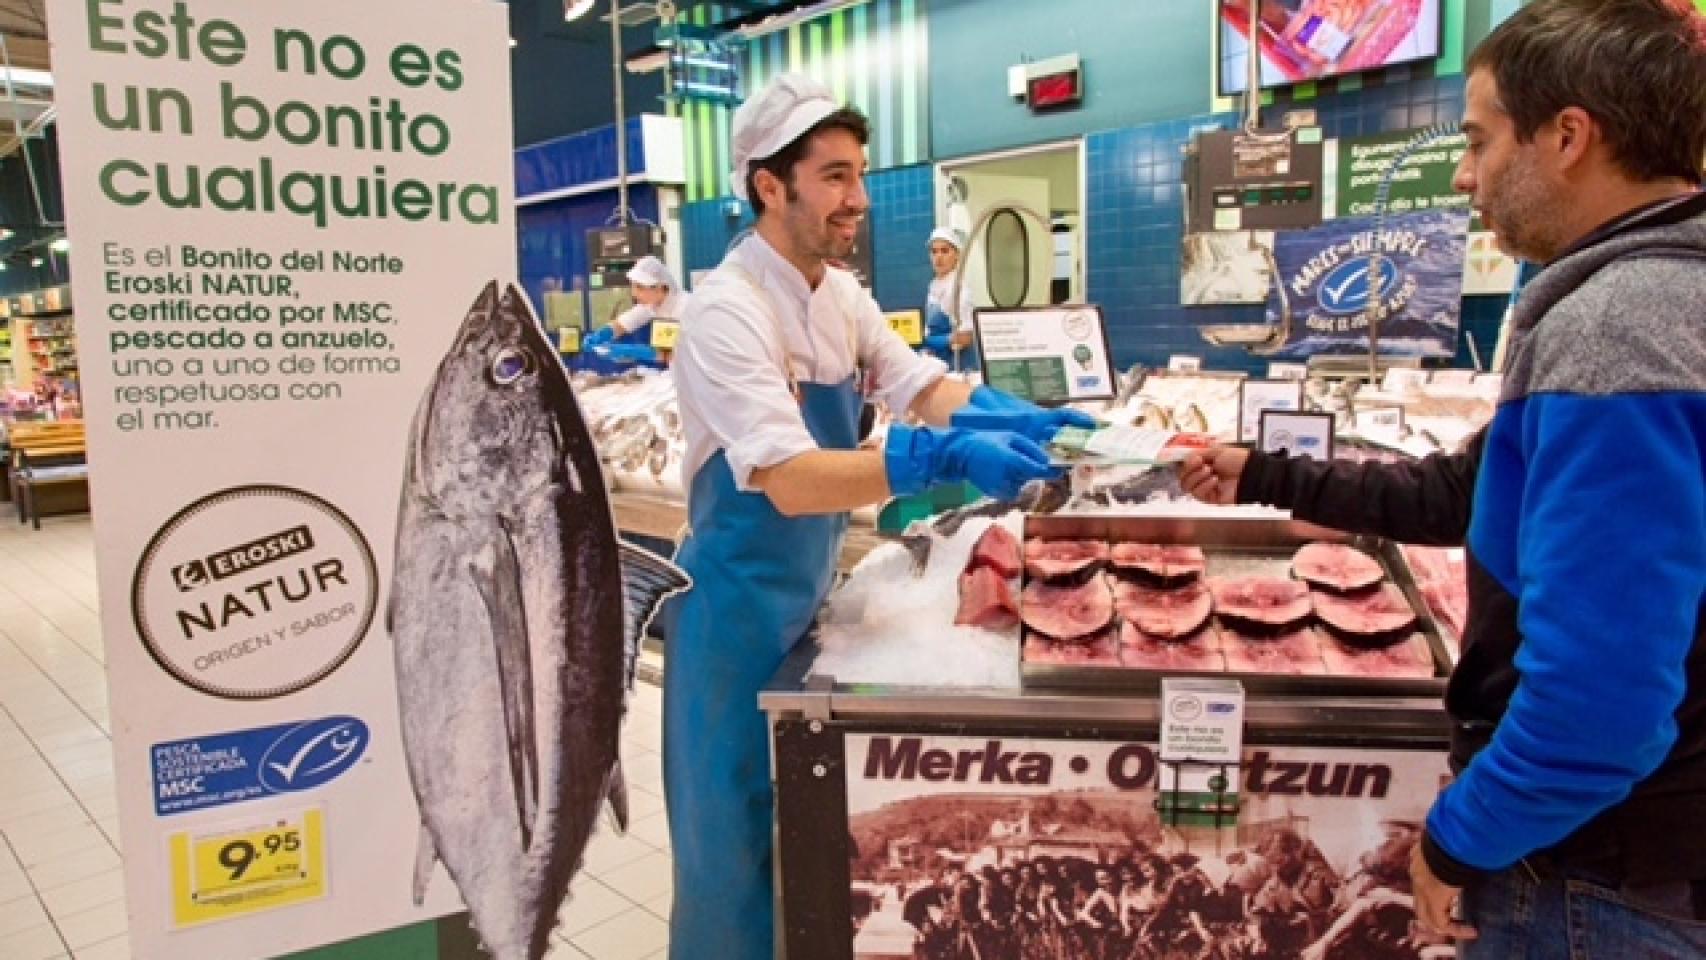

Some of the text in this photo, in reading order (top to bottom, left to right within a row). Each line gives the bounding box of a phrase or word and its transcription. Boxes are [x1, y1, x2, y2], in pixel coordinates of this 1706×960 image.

[86, 0, 464, 91] Este no es
[92, 80, 450, 155] un bonito
[99, 156, 499, 227] cualquiera
[103, 242, 403, 274] Es el Bonito del Norte
[105, 271, 300, 299] Eroski NATUR,
[108, 300, 270, 322] certificado
[280, 305, 325, 327] por
[110, 327, 395, 353] pescado a anzuelo,
[112, 352, 400, 376] uno a uno de forma
[114, 380, 341, 407] respetuosa con
[116, 408, 219, 431] el mar.
[213, 529, 310, 575] EROSKI
[176, 558, 348, 640] NATUR
[193, 601, 356, 672] ORIGEN Y SABOR
[863, 736, 1393, 799] Merka Otzun
[159, 776, 205, 798] MSC
